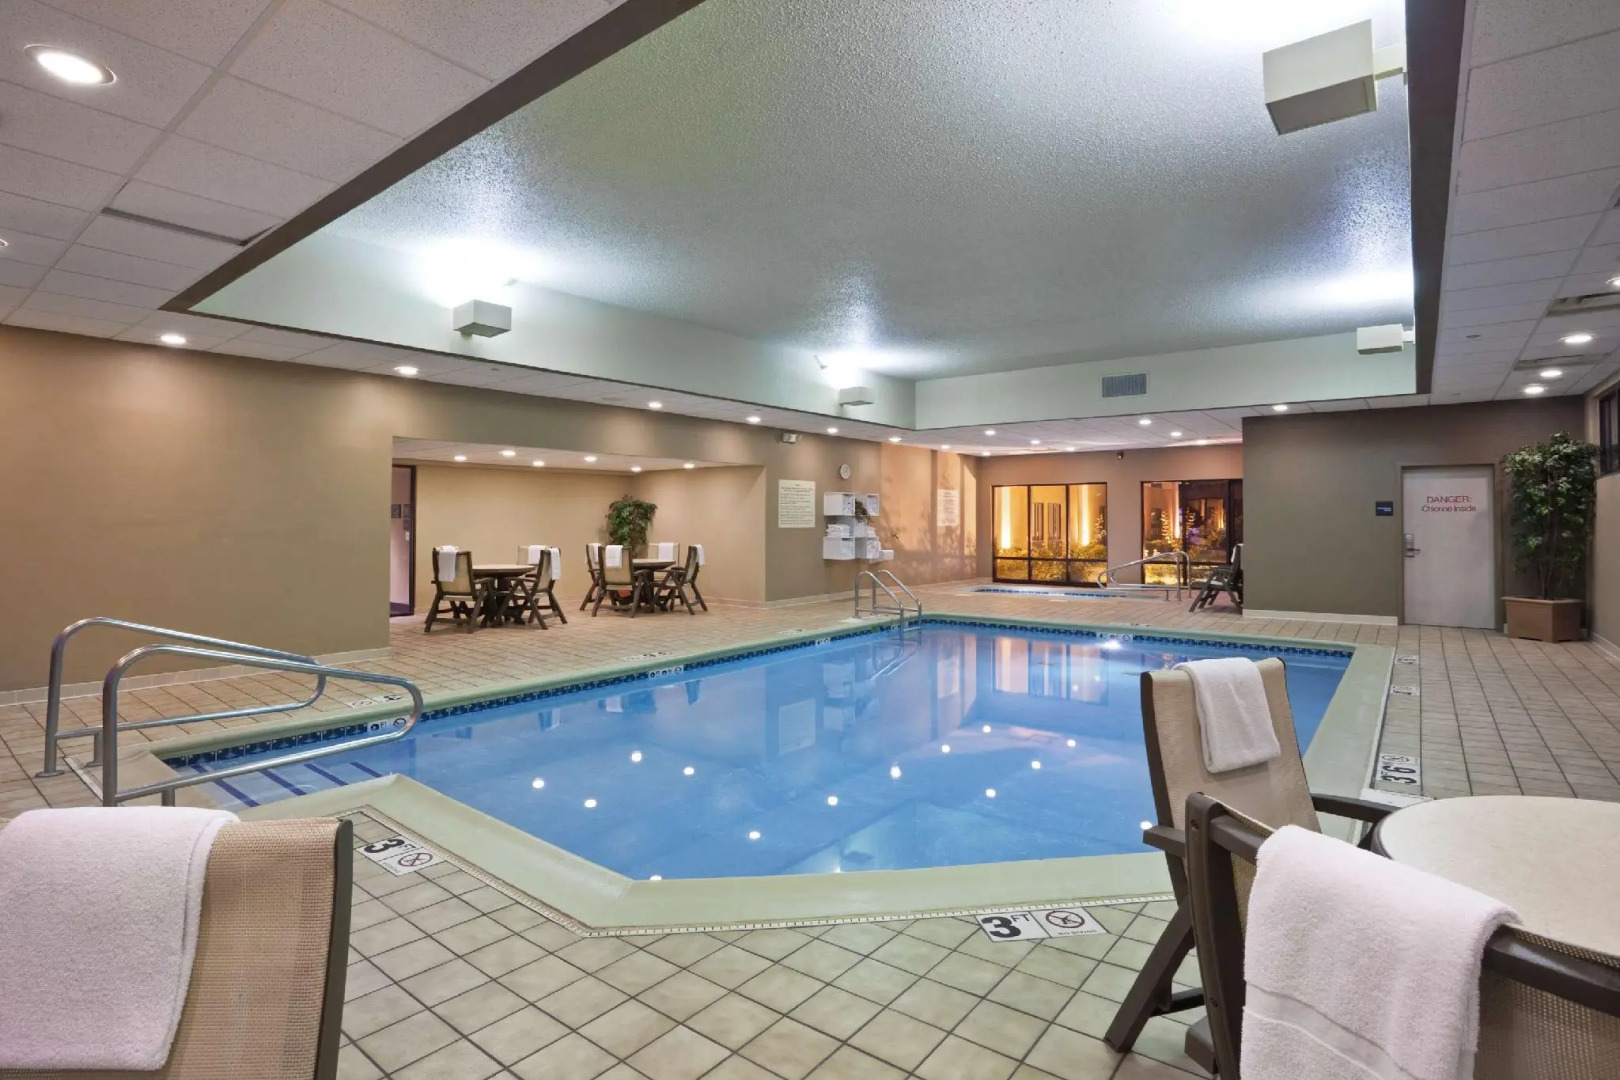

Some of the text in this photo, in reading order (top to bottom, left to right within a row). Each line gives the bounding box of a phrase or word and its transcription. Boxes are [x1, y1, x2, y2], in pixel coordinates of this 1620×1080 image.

[363, 838, 405, 854] 3
[980, 913, 1031, 938] 3 FT
